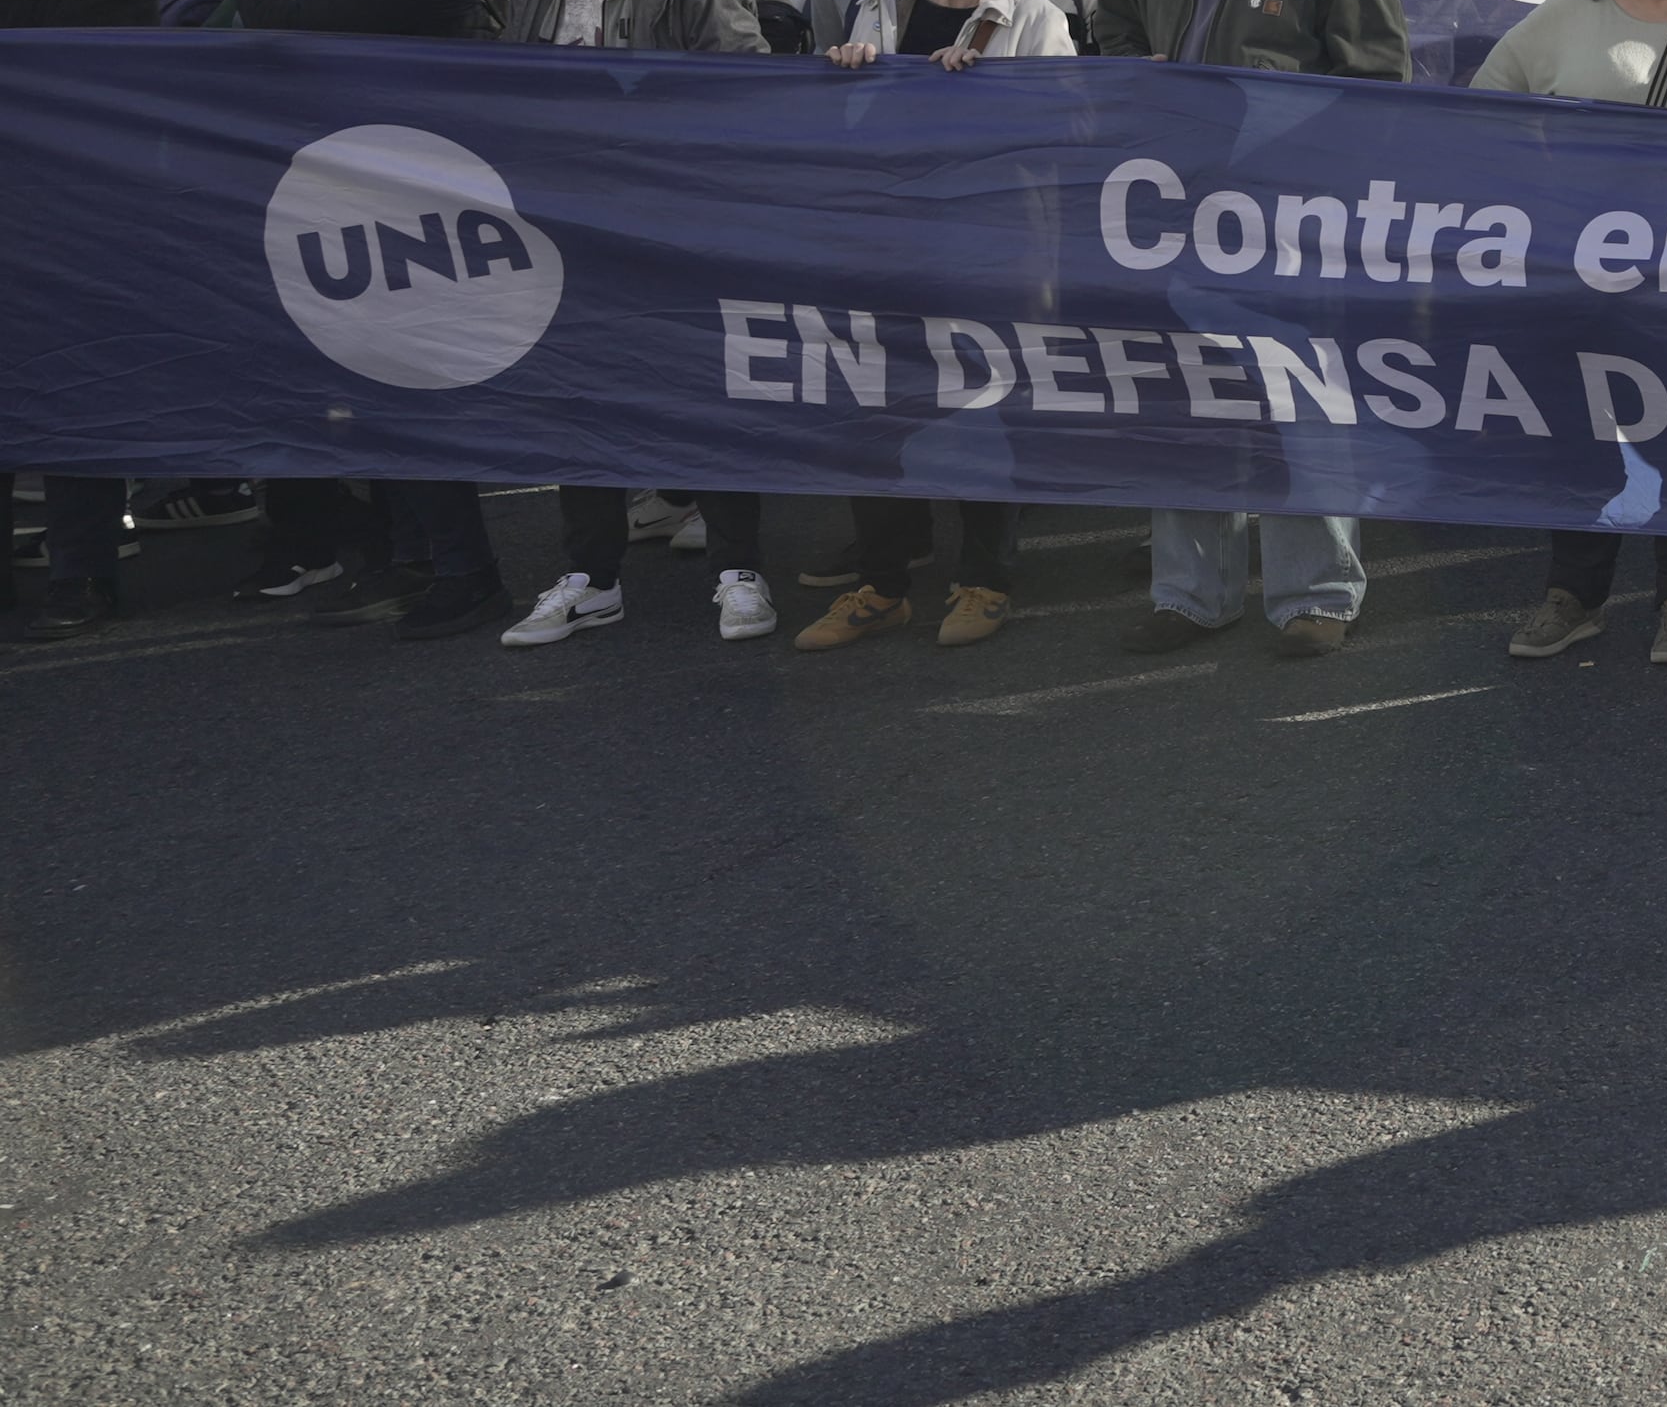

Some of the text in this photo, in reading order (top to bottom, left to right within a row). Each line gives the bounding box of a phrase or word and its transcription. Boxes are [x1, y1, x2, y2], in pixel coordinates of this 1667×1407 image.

[297, 208, 534, 301] UNA
[1100, 157, 1529, 288] Contra
[717, 298, 888, 408] EN
[927, 315, 1552, 438] DEFENSA
